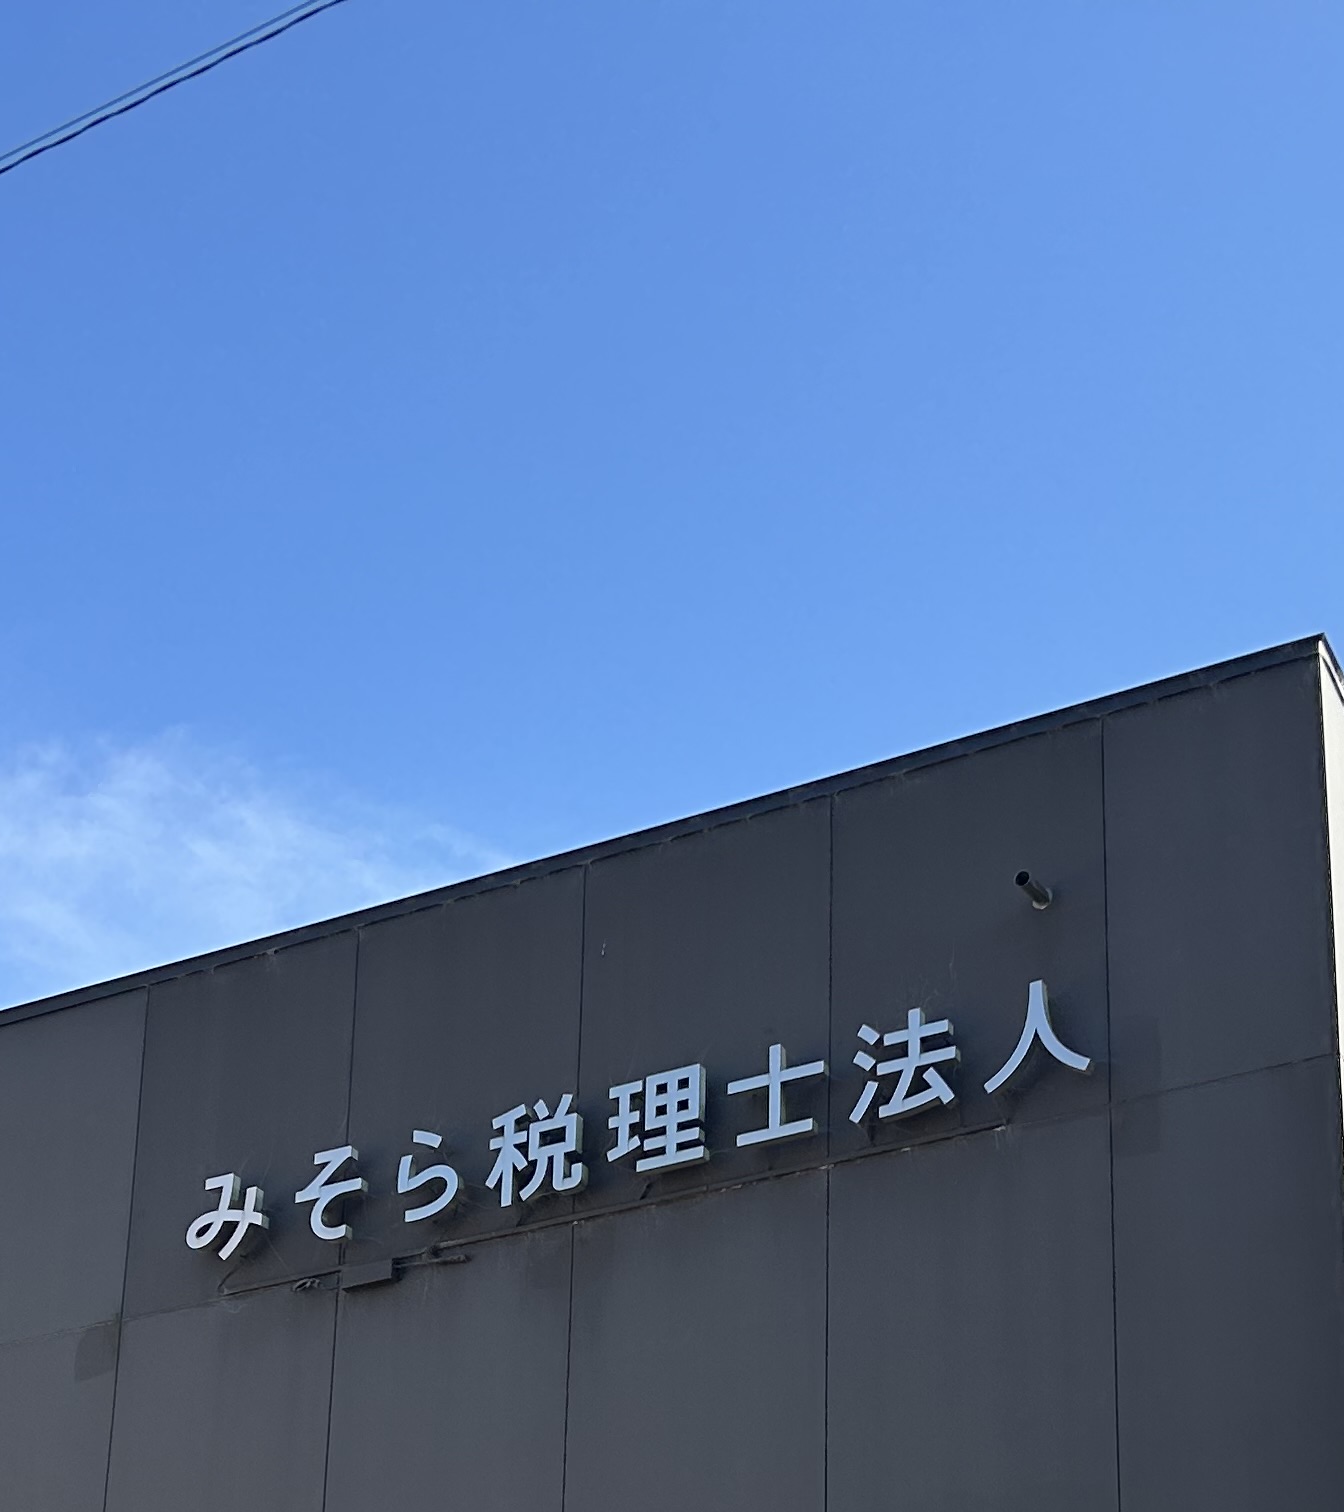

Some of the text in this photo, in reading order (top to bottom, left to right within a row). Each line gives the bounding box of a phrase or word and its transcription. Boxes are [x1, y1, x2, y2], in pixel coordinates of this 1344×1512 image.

[185, 979, 1090, 1261] みそら税理士法人
